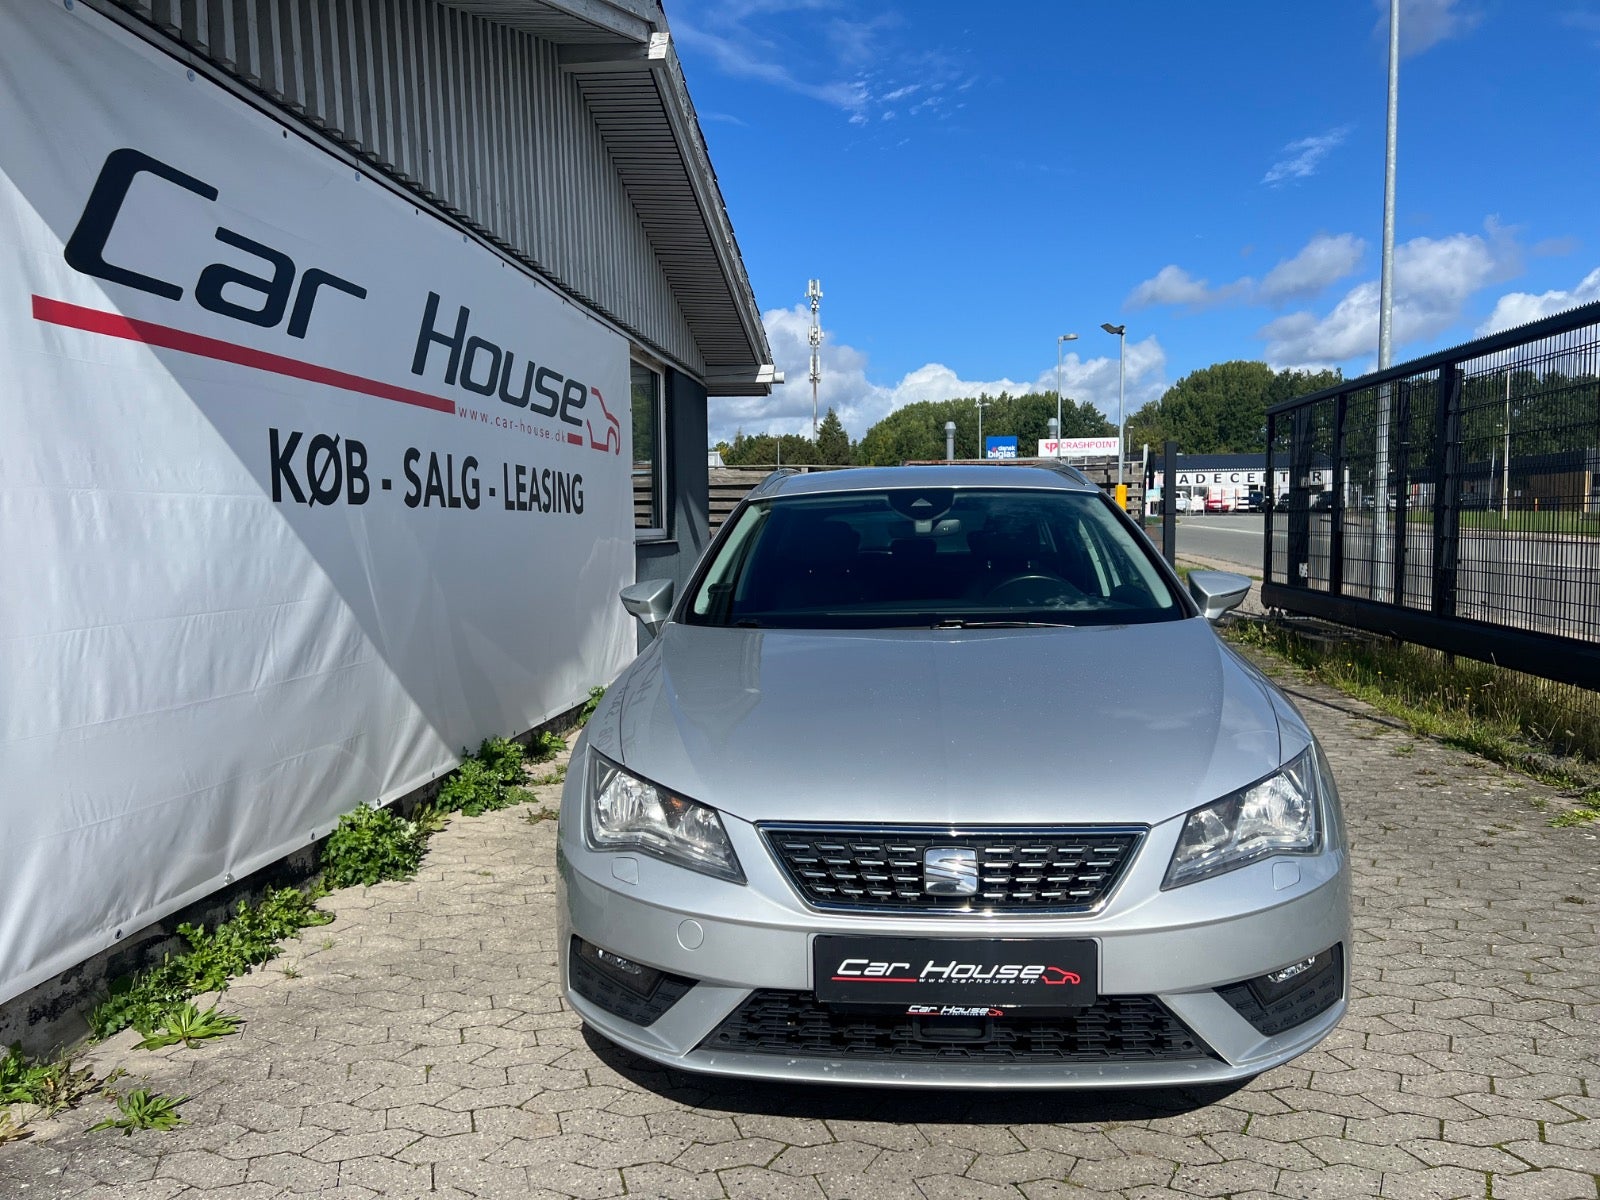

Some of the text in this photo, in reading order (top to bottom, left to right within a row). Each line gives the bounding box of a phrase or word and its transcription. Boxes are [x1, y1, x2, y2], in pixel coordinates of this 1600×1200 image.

[64, 148, 588, 427] Car House
[458, 407, 566, 443] www.car-house.dk
[1060, 440, 1117, 449] CRASHPOINT
[987, 450, 1016, 459] bilglas
[269, 427, 370, 508] KØB
[403, 447, 480, 510] SALG
[503, 462, 584, 515] LEASING
[1179, 471, 1322, 485] ADECETR
[837, 959, 1046, 979] Car House
[908, 1005, 938, 1013] Car
[940, 1005, 990, 1015] House
